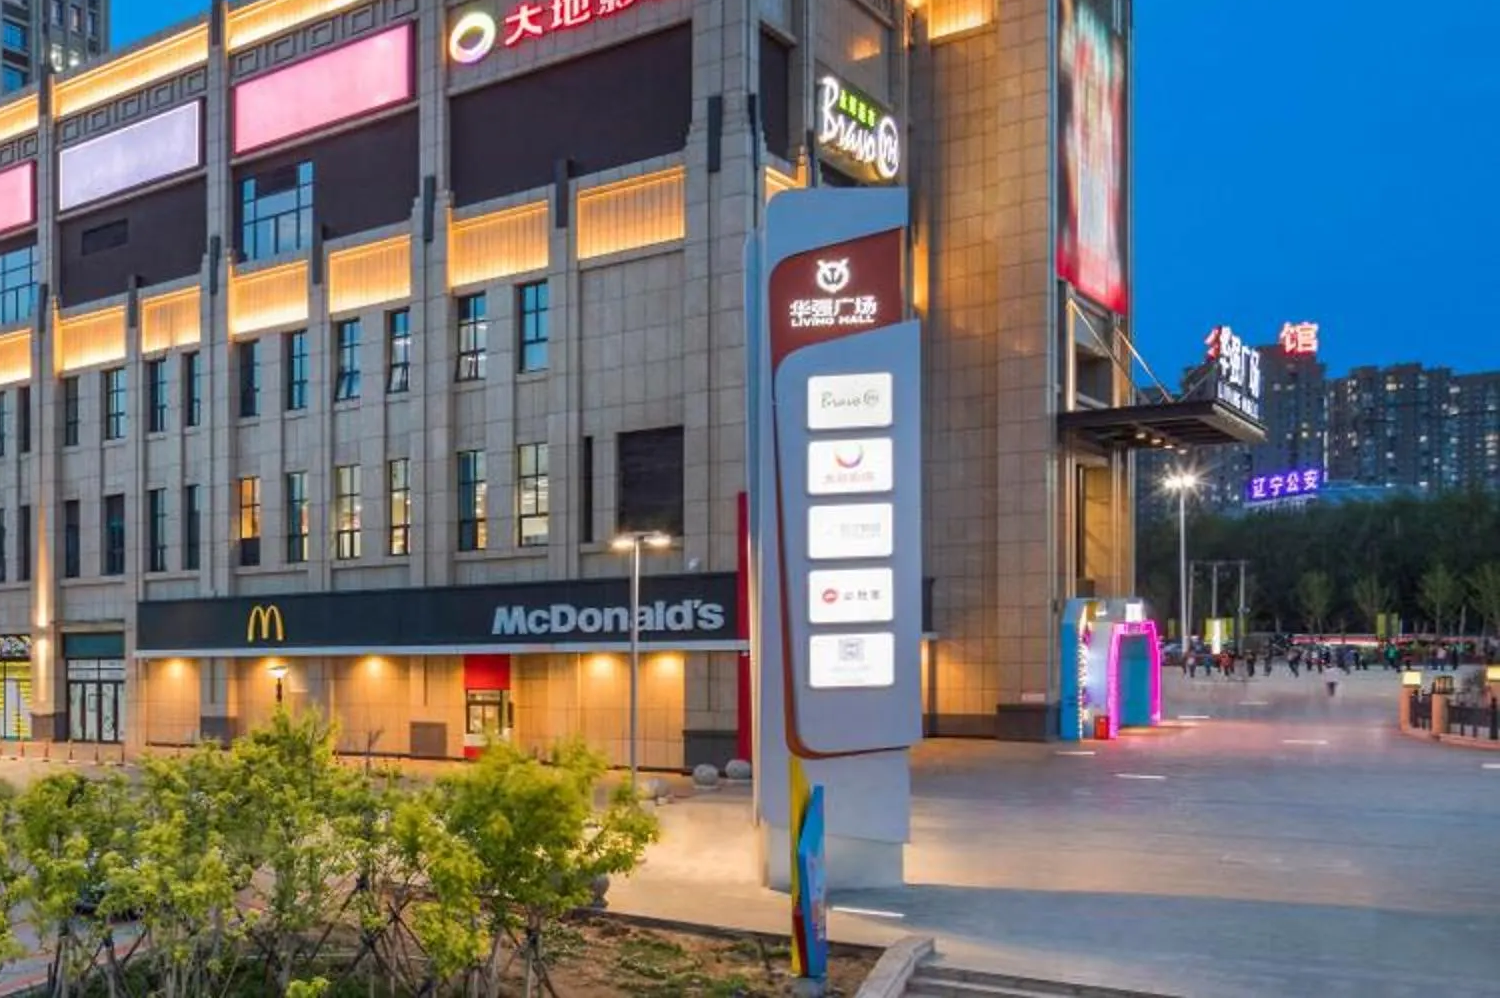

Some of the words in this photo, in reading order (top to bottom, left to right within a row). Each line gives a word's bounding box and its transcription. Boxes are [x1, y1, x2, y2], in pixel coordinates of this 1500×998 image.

[1280, 322, 1318, 353] 馆
[1252, 469, 1318, 499] 辽宁公安
[492, 600, 725, 635] McDonald's
